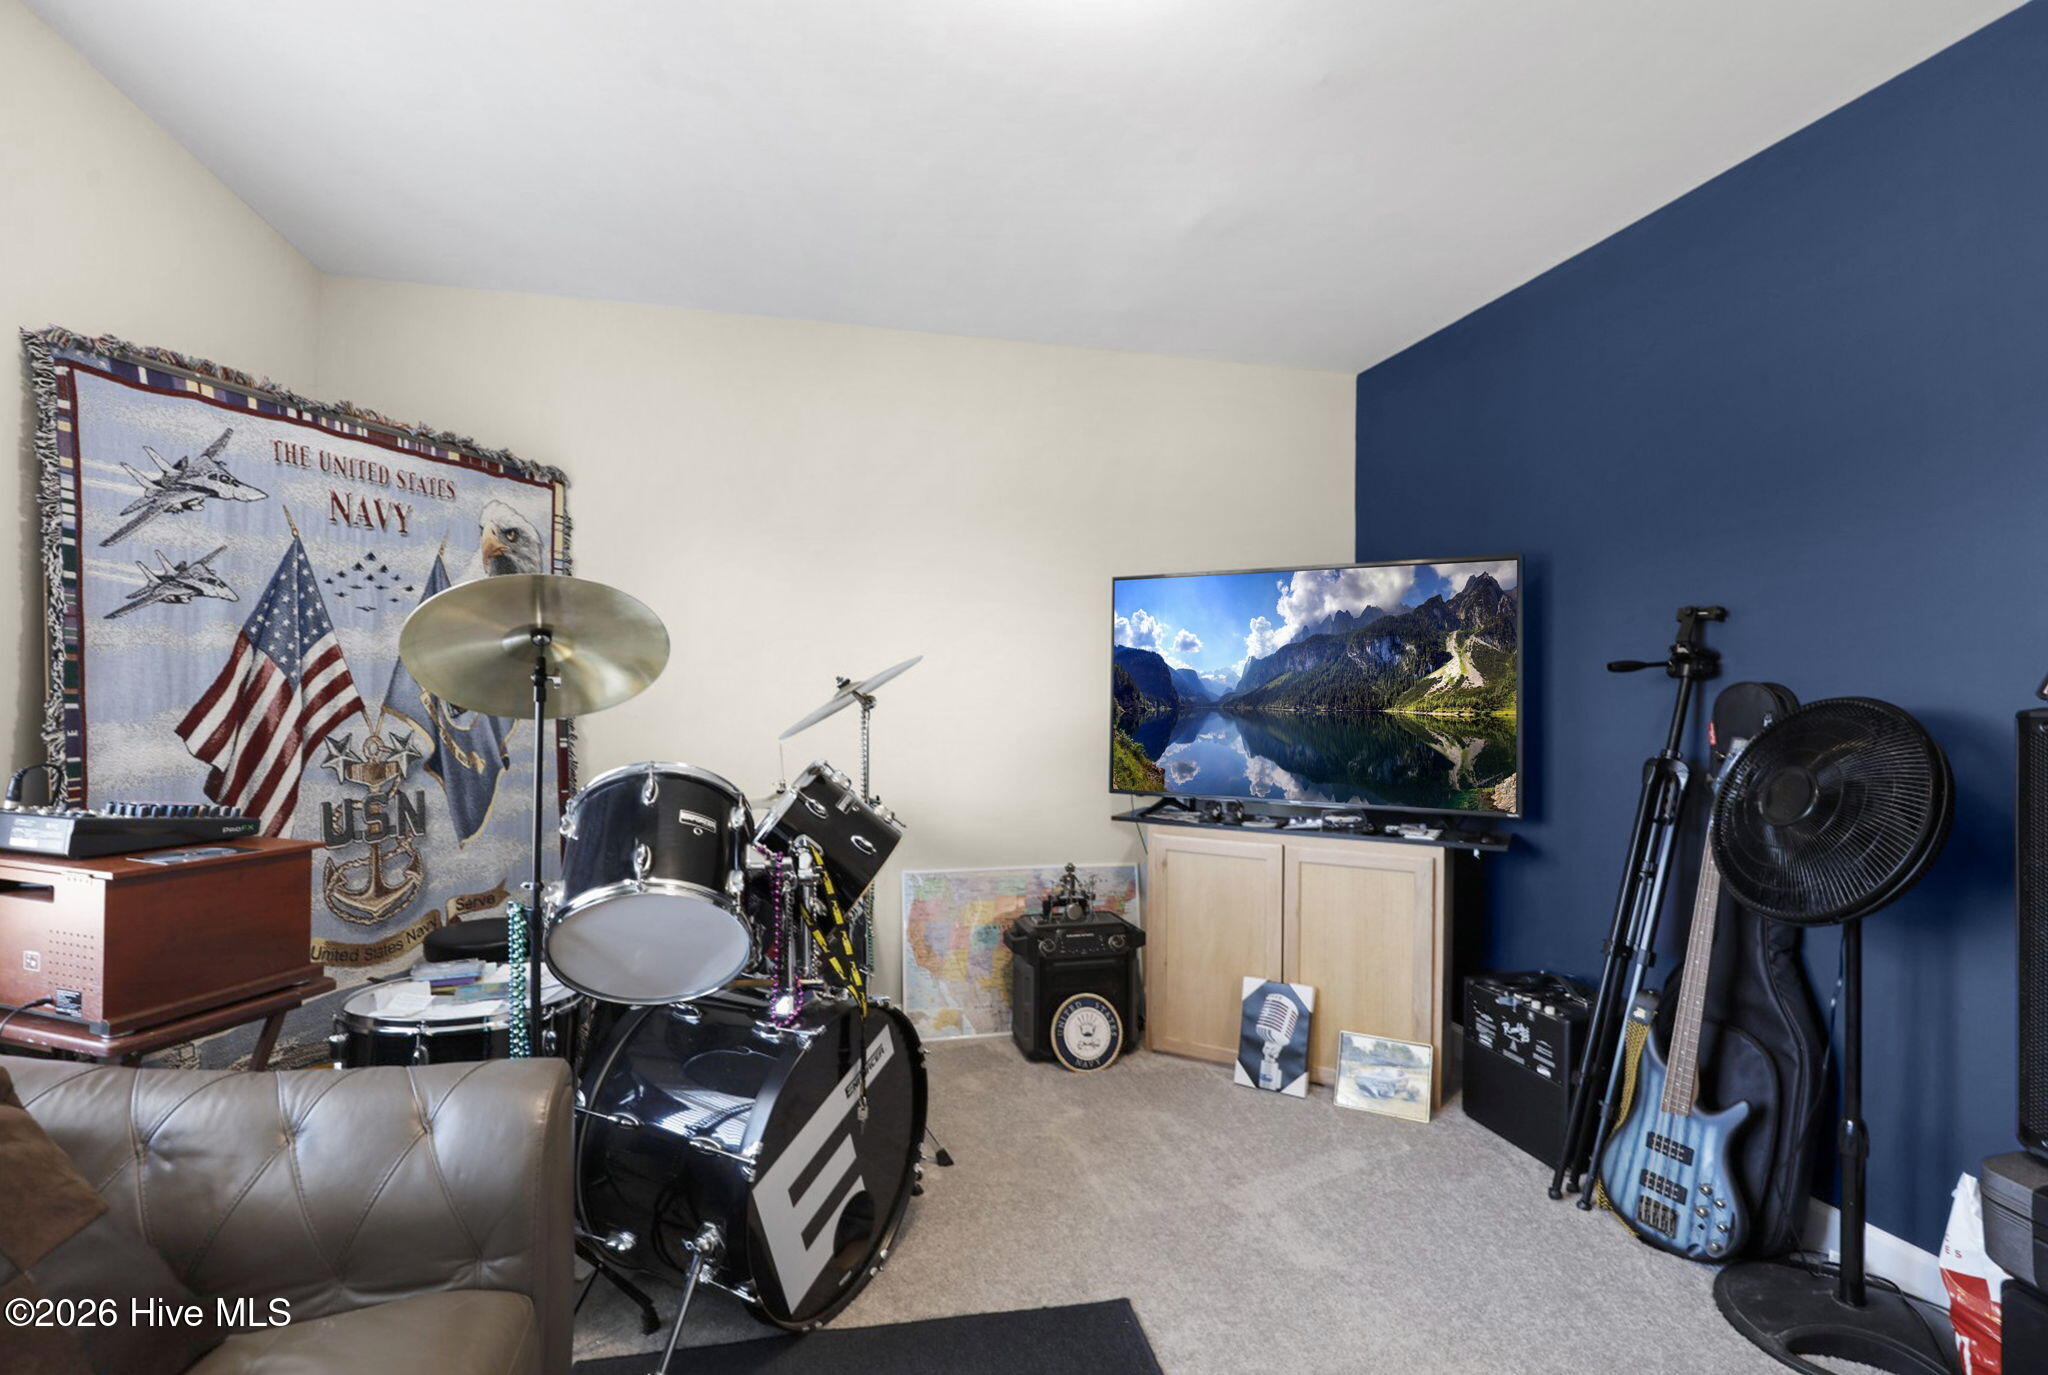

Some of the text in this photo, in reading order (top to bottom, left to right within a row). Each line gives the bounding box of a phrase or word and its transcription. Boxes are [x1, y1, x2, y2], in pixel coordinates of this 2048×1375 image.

[272, 440, 456, 499] THE UNITED STATES
[329, 488, 412, 535] NAVY
[455, 893, 496, 911] Serve
[311, 918, 438, 962] United States Navy
